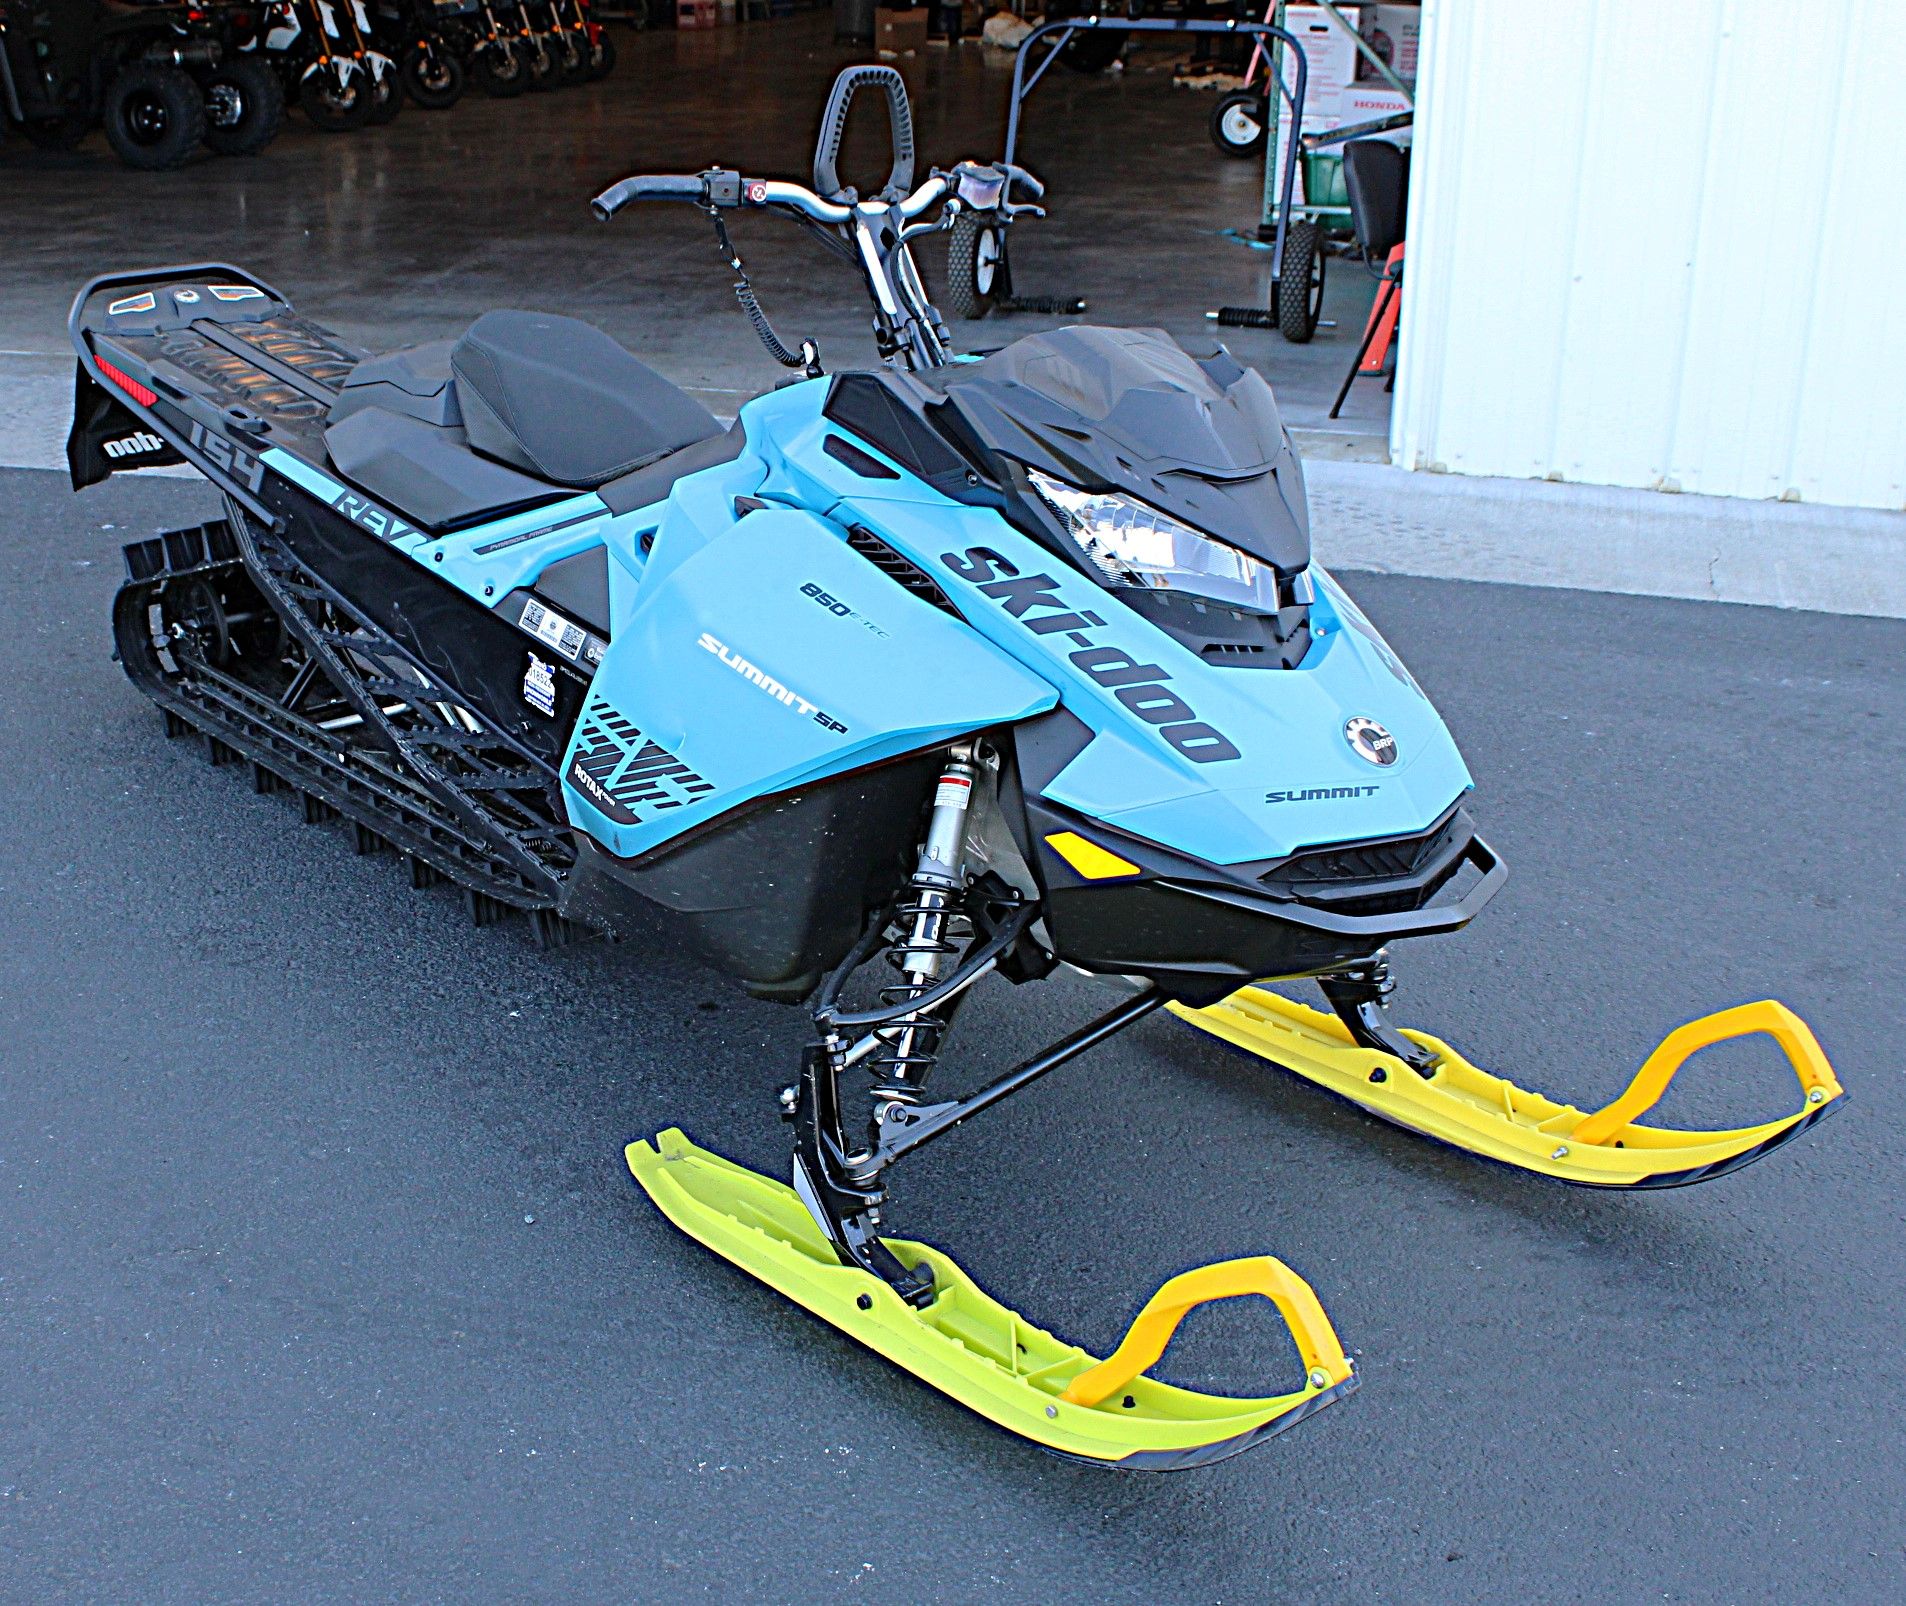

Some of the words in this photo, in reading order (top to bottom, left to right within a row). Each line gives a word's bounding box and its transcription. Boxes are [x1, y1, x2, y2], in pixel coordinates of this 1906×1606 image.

[1354, 101, 1405, 110] HONDA
[189, 420, 265, 495] 154
[799, 582, 852, 617] 850
[940, 546, 1242, 763] ski-doo
[696, 632, 819, 715] SUMMIT
[813, 711, 848, 735] SP
[1372, 736, 1394, 751] BRP
[574, 763, 604, 801] ROTAX
[1265, 786, 1380, 804] SUMMIT
